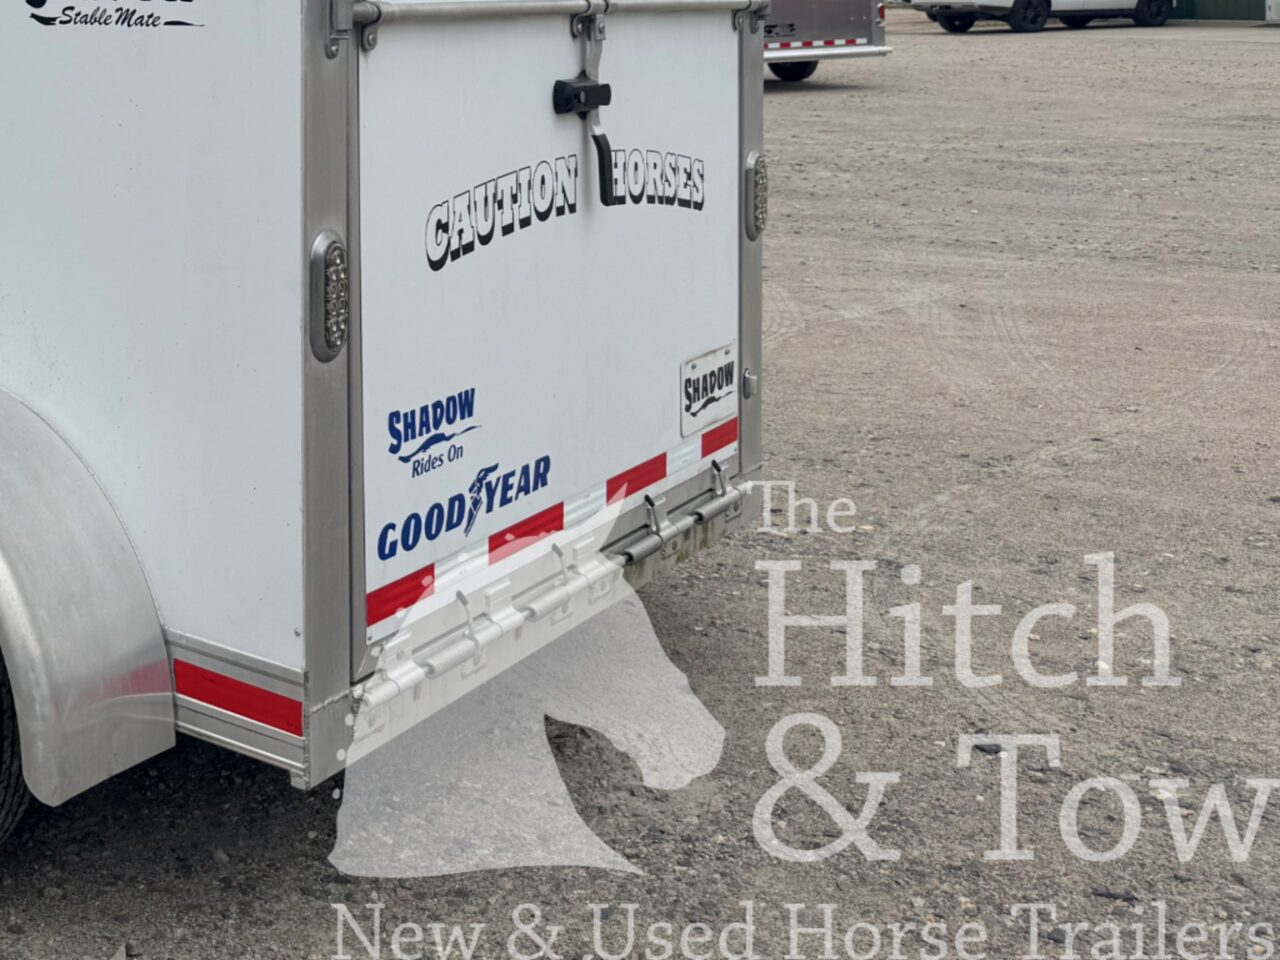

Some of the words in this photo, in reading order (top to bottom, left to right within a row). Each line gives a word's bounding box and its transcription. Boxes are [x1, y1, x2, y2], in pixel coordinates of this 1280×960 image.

[425, 154, 577, 271] CAUTION
[610, 148, 704, 211] HORSES
[685, 360, 734, 413] SHADOW
[388, 388, 475, 454] SHADOW
[412, 452, 444, 478] Rides
[448, 444, 463, 462] On
